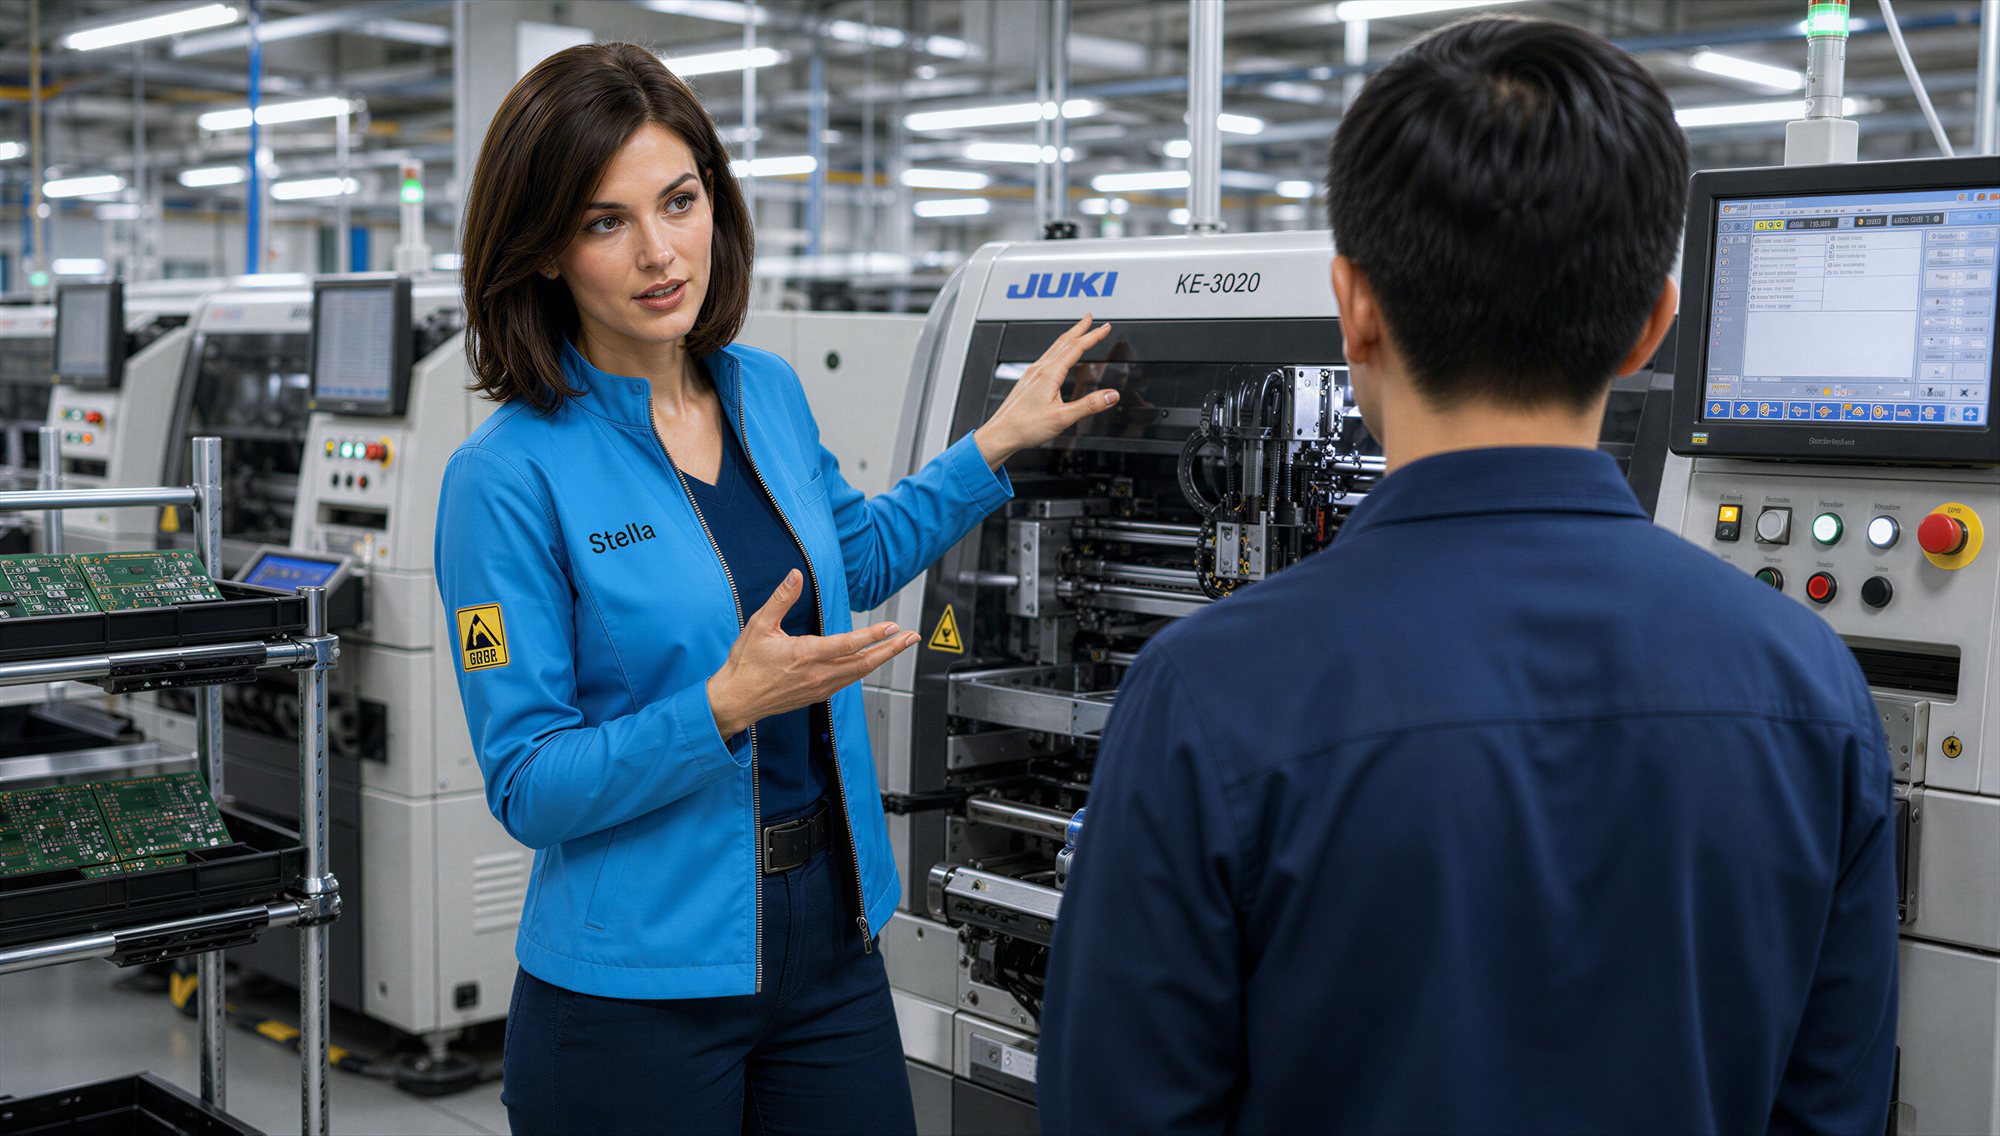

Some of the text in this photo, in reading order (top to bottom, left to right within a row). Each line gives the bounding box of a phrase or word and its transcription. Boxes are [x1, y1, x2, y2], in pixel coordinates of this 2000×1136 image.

[1006, 271, 1119, 299] JUKI
[1175, 272, 1261, 294] KE-3020
[588, 522, 657, 554] Stella
